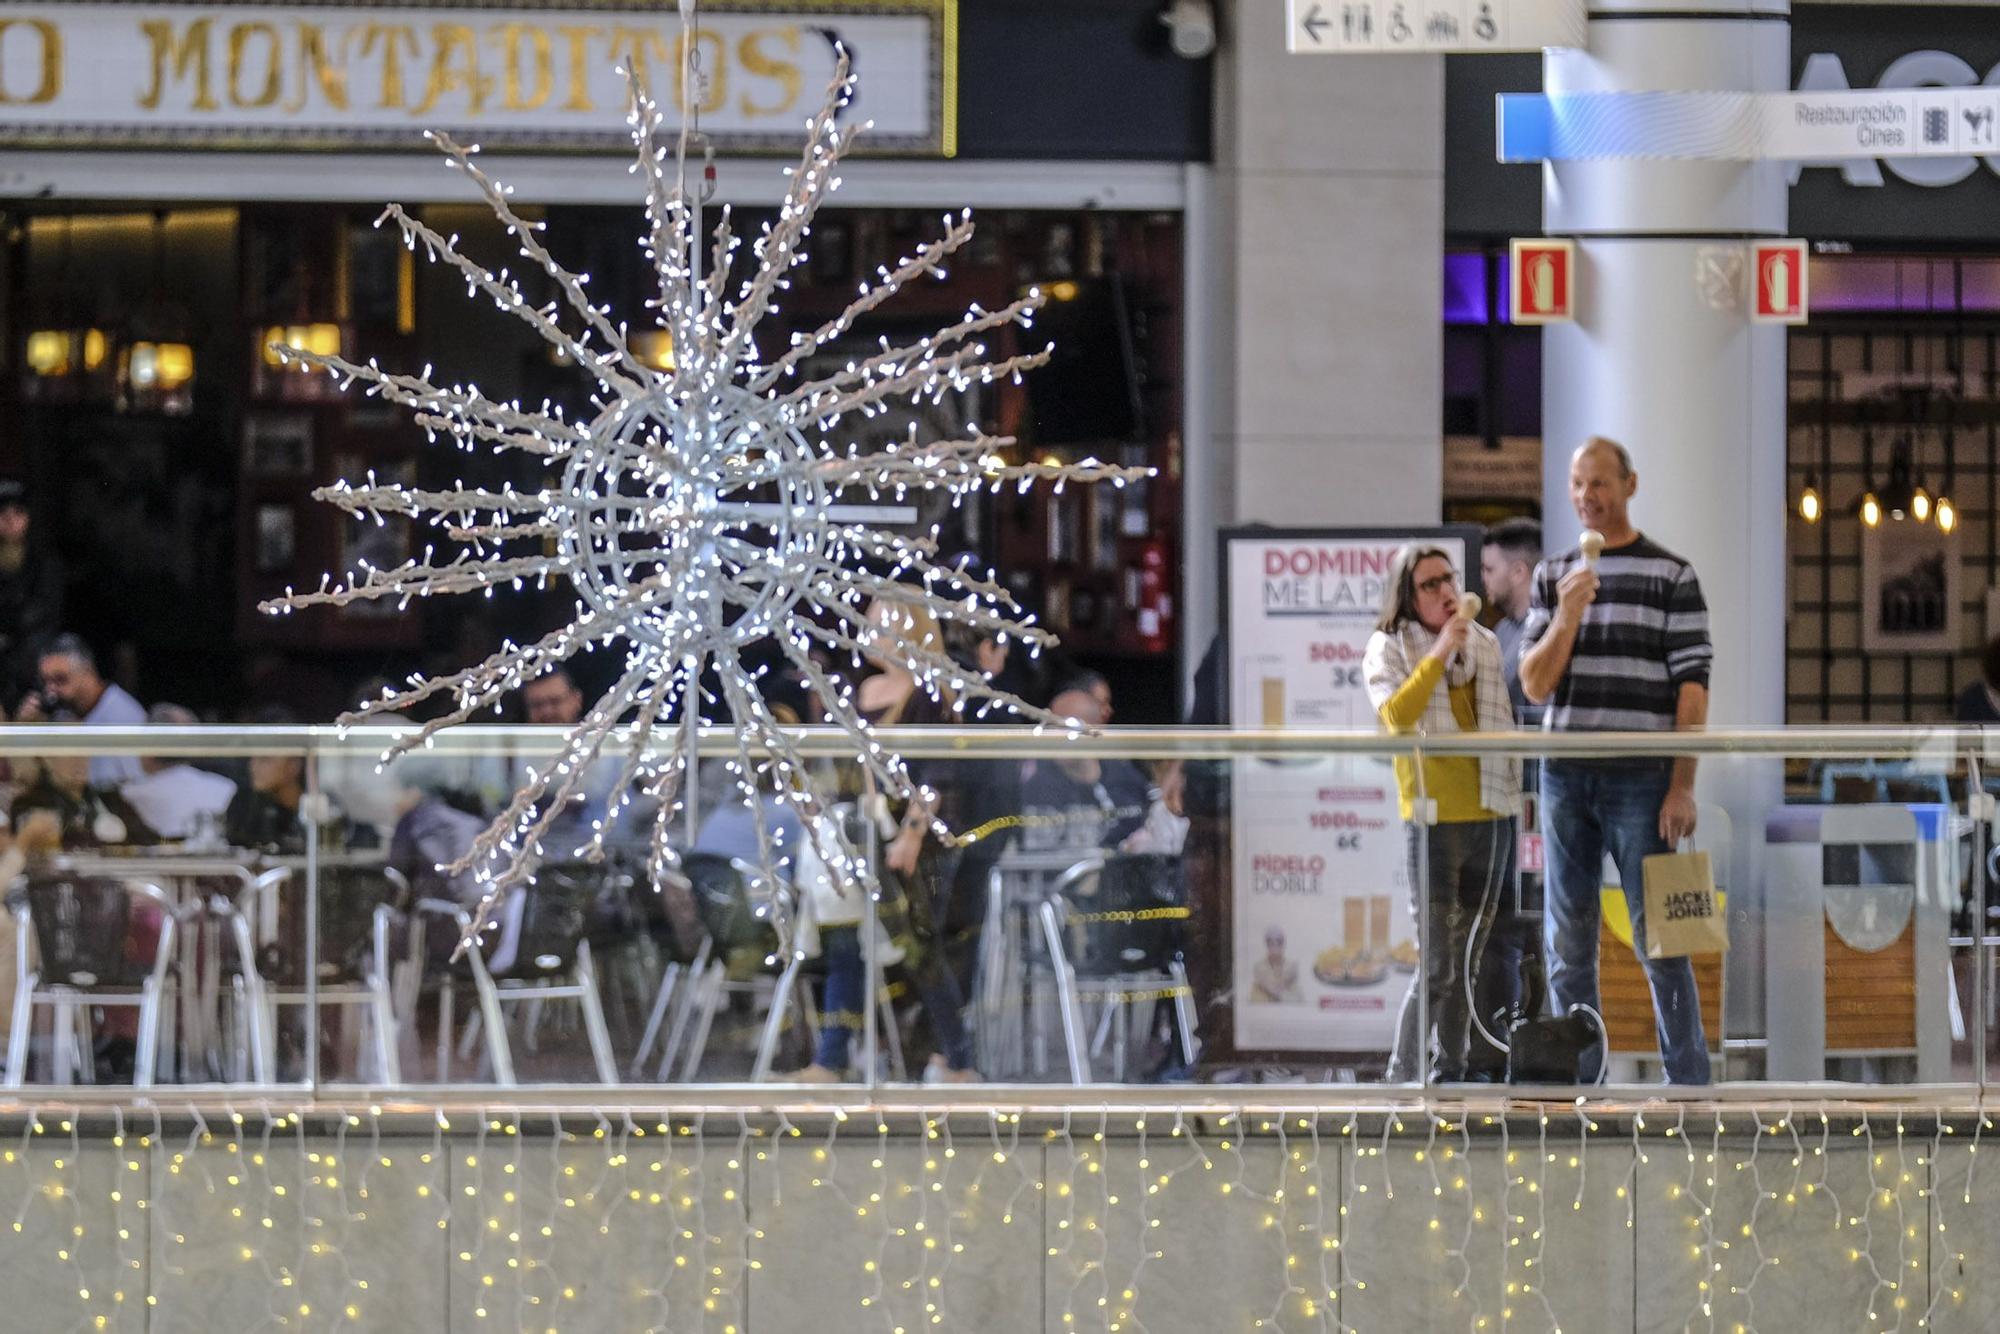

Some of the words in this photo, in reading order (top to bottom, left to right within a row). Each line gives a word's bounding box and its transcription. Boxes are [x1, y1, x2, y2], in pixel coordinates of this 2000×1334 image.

[136, 18, 802, 117] MONTADITOS
[1857, 124, 1905, 147] Cines
[1265, 581, 1309, 606] ME
[1319, 581, 1356, 606] LA
